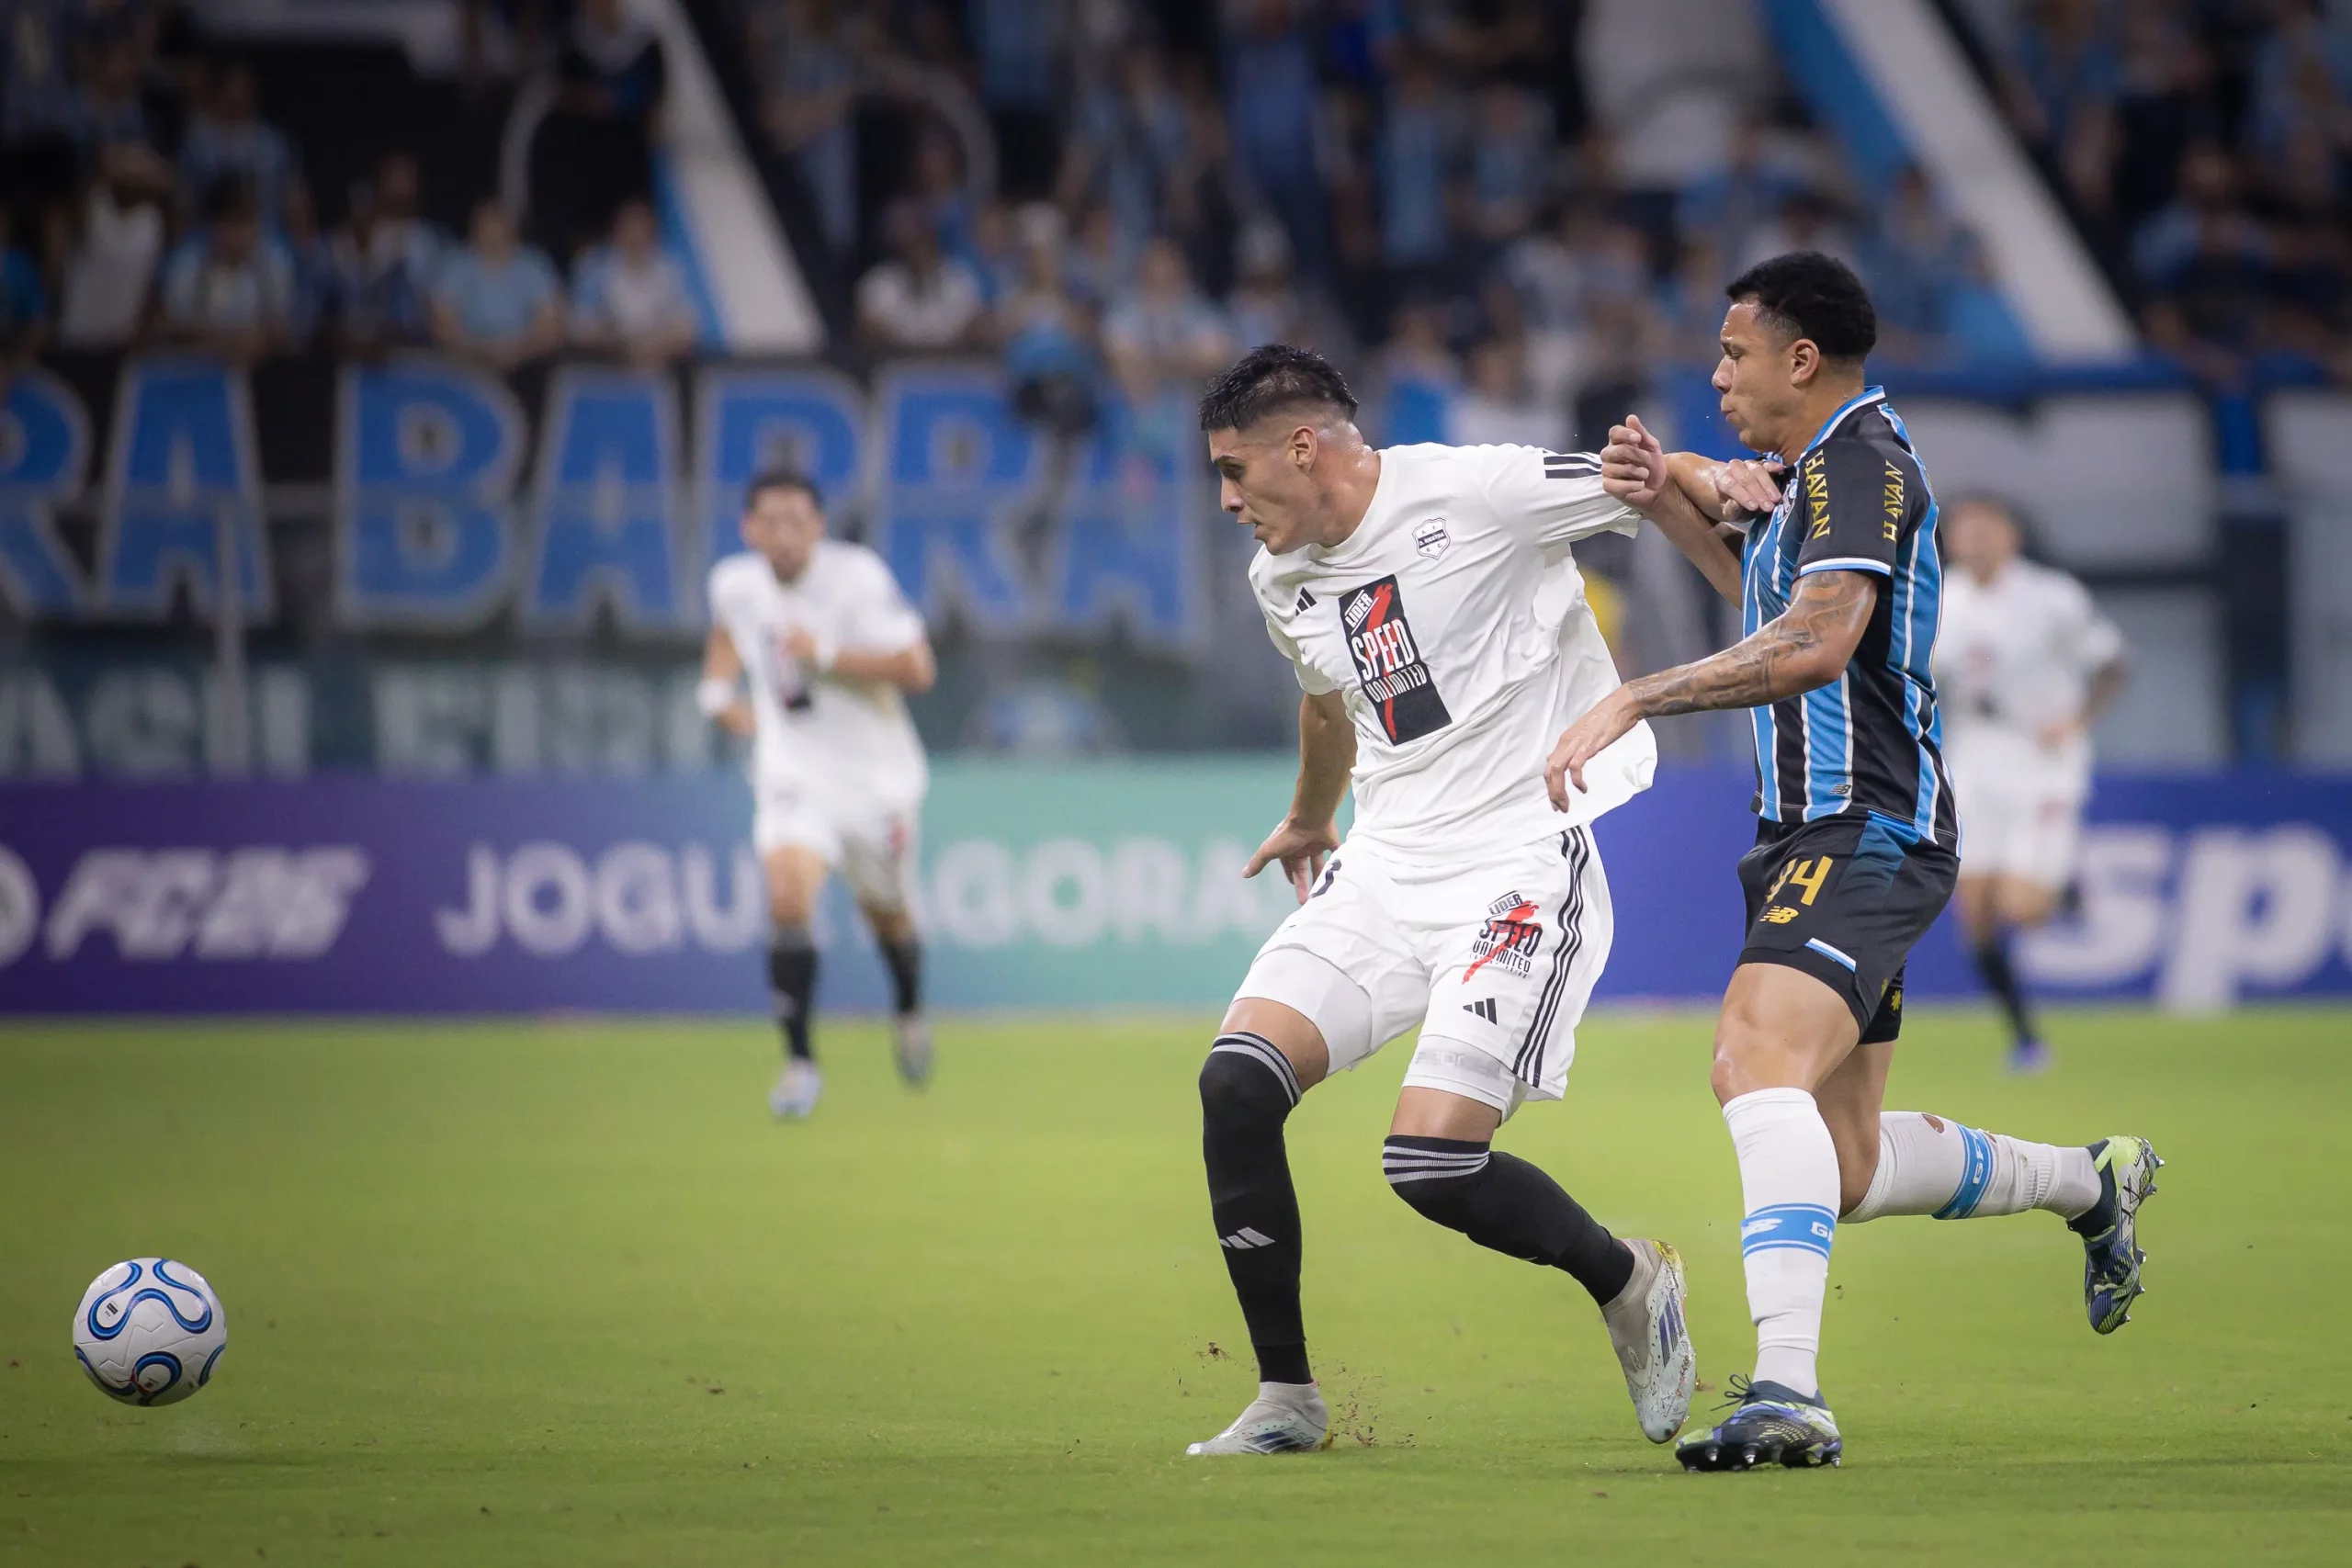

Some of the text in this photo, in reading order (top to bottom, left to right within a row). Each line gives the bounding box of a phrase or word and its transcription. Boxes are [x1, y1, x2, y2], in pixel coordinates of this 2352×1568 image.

[1805, 449, 1830, 539] HAVAN
[1883, 459, 1904, 544] HAVAN
[1345, 592, 1374, 628] LIDER
[1351, 618, 1415, 682] SPEED
[1364, 663, 1427, 704] UNLIMITED
[1488, 893, 1523, 916] LIDER
[1473, 940, 1532, 974] UNLIMITED
